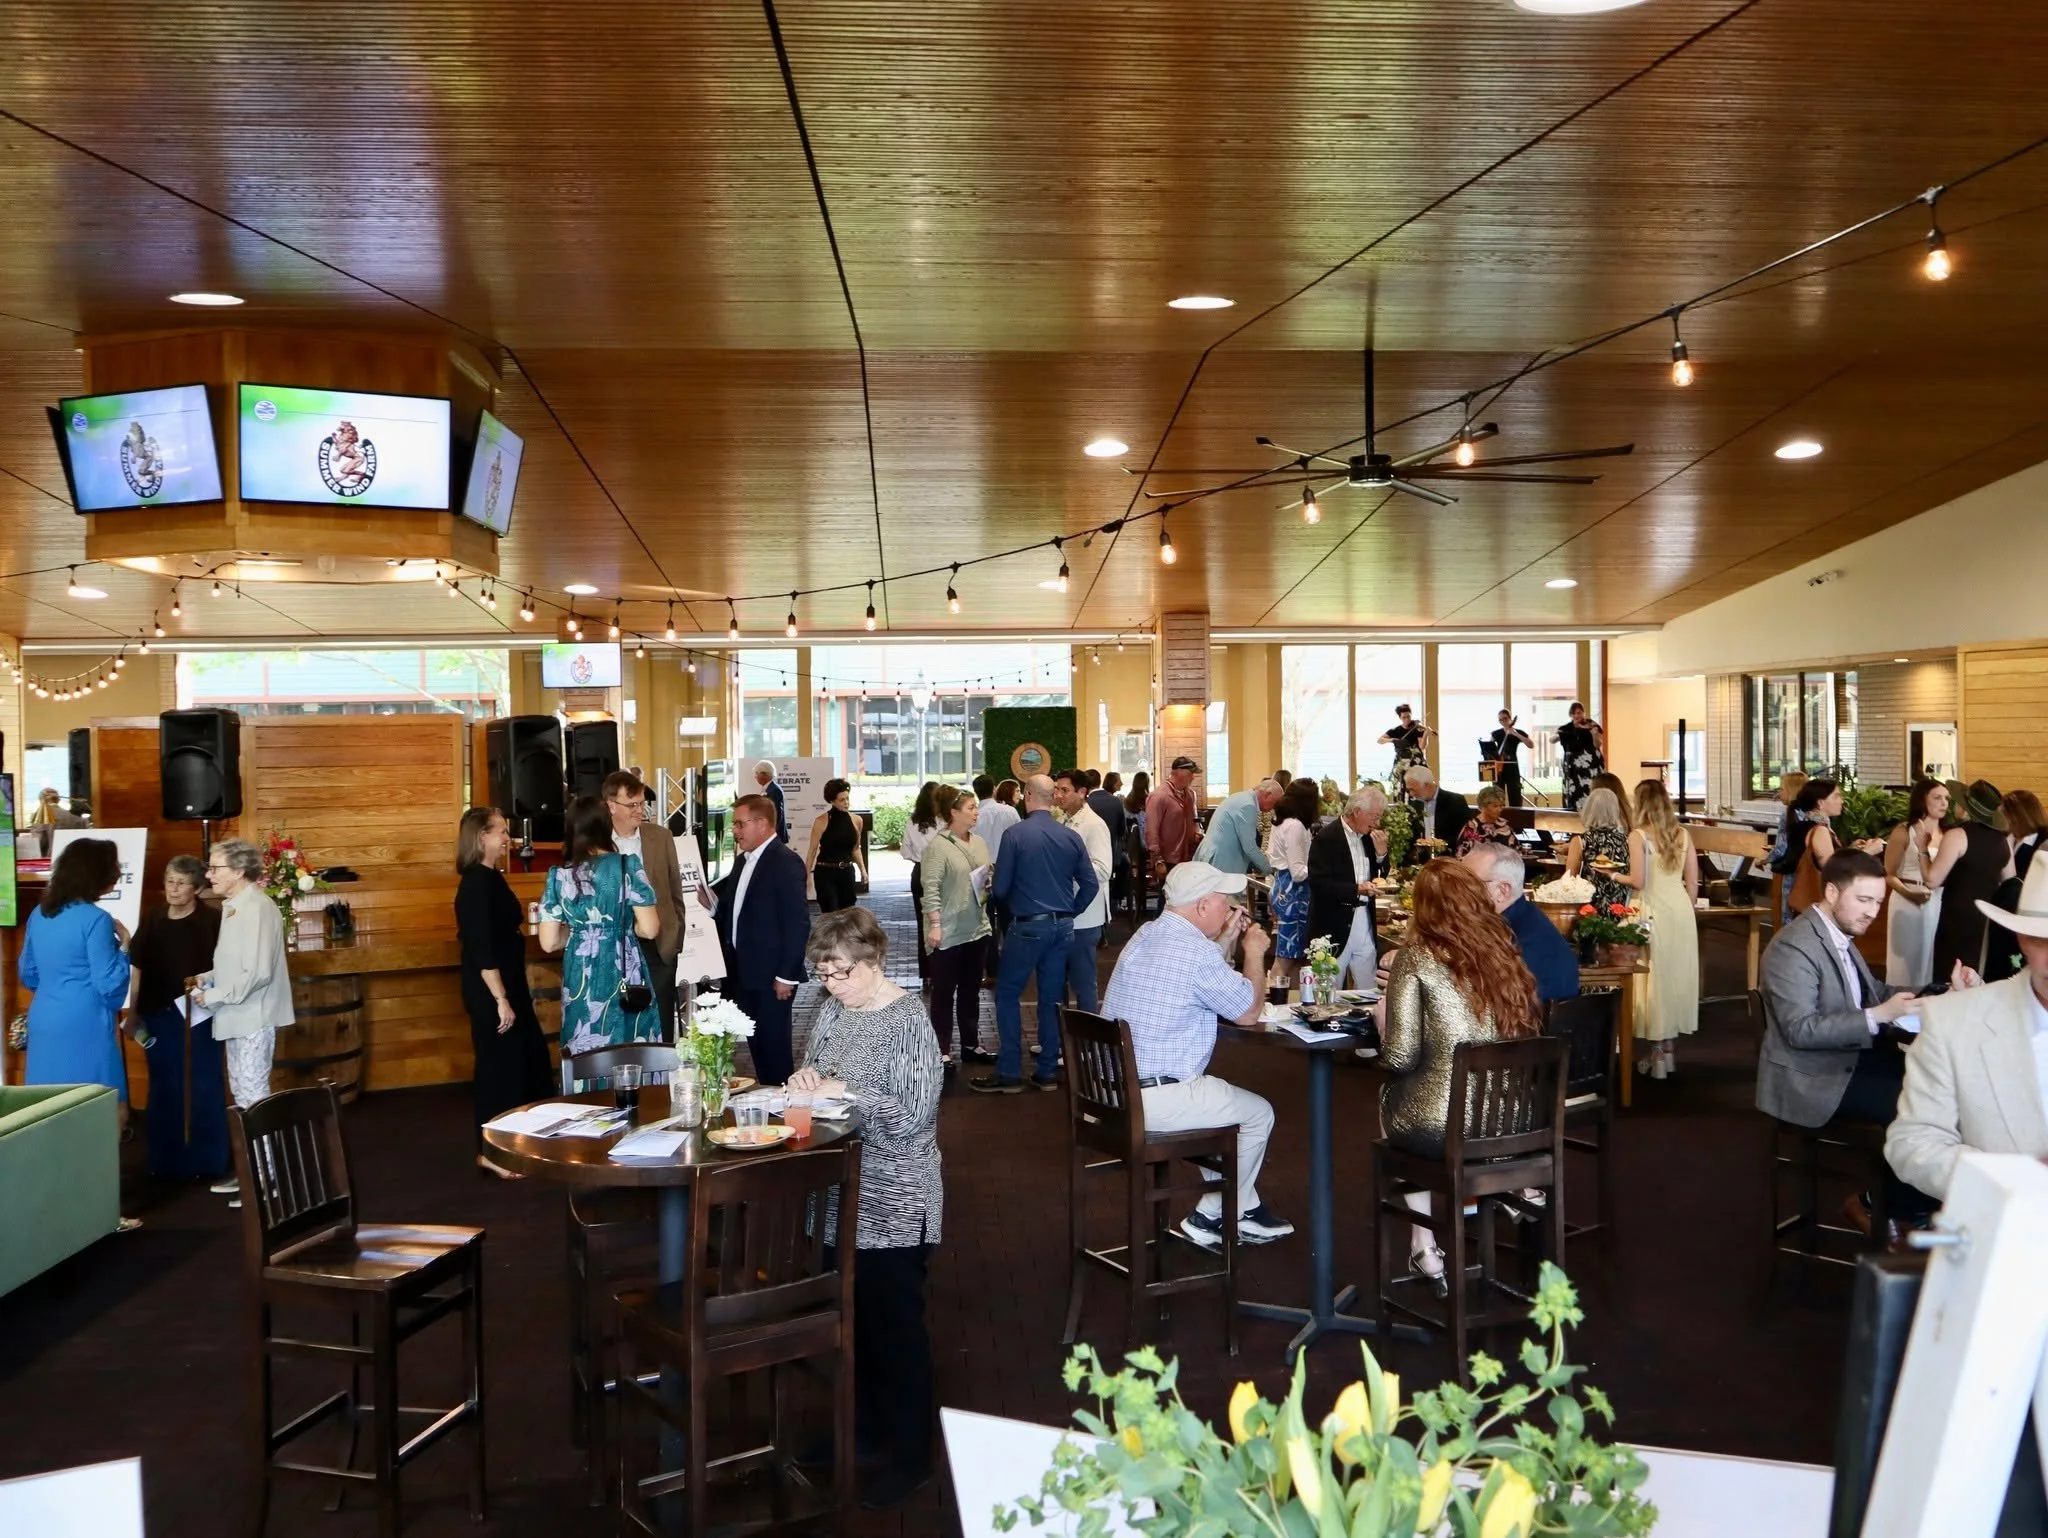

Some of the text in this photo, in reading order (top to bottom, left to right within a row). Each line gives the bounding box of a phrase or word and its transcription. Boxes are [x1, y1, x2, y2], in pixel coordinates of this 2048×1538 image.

[319, 442, 376, 496] SUMMER WIND FARM
